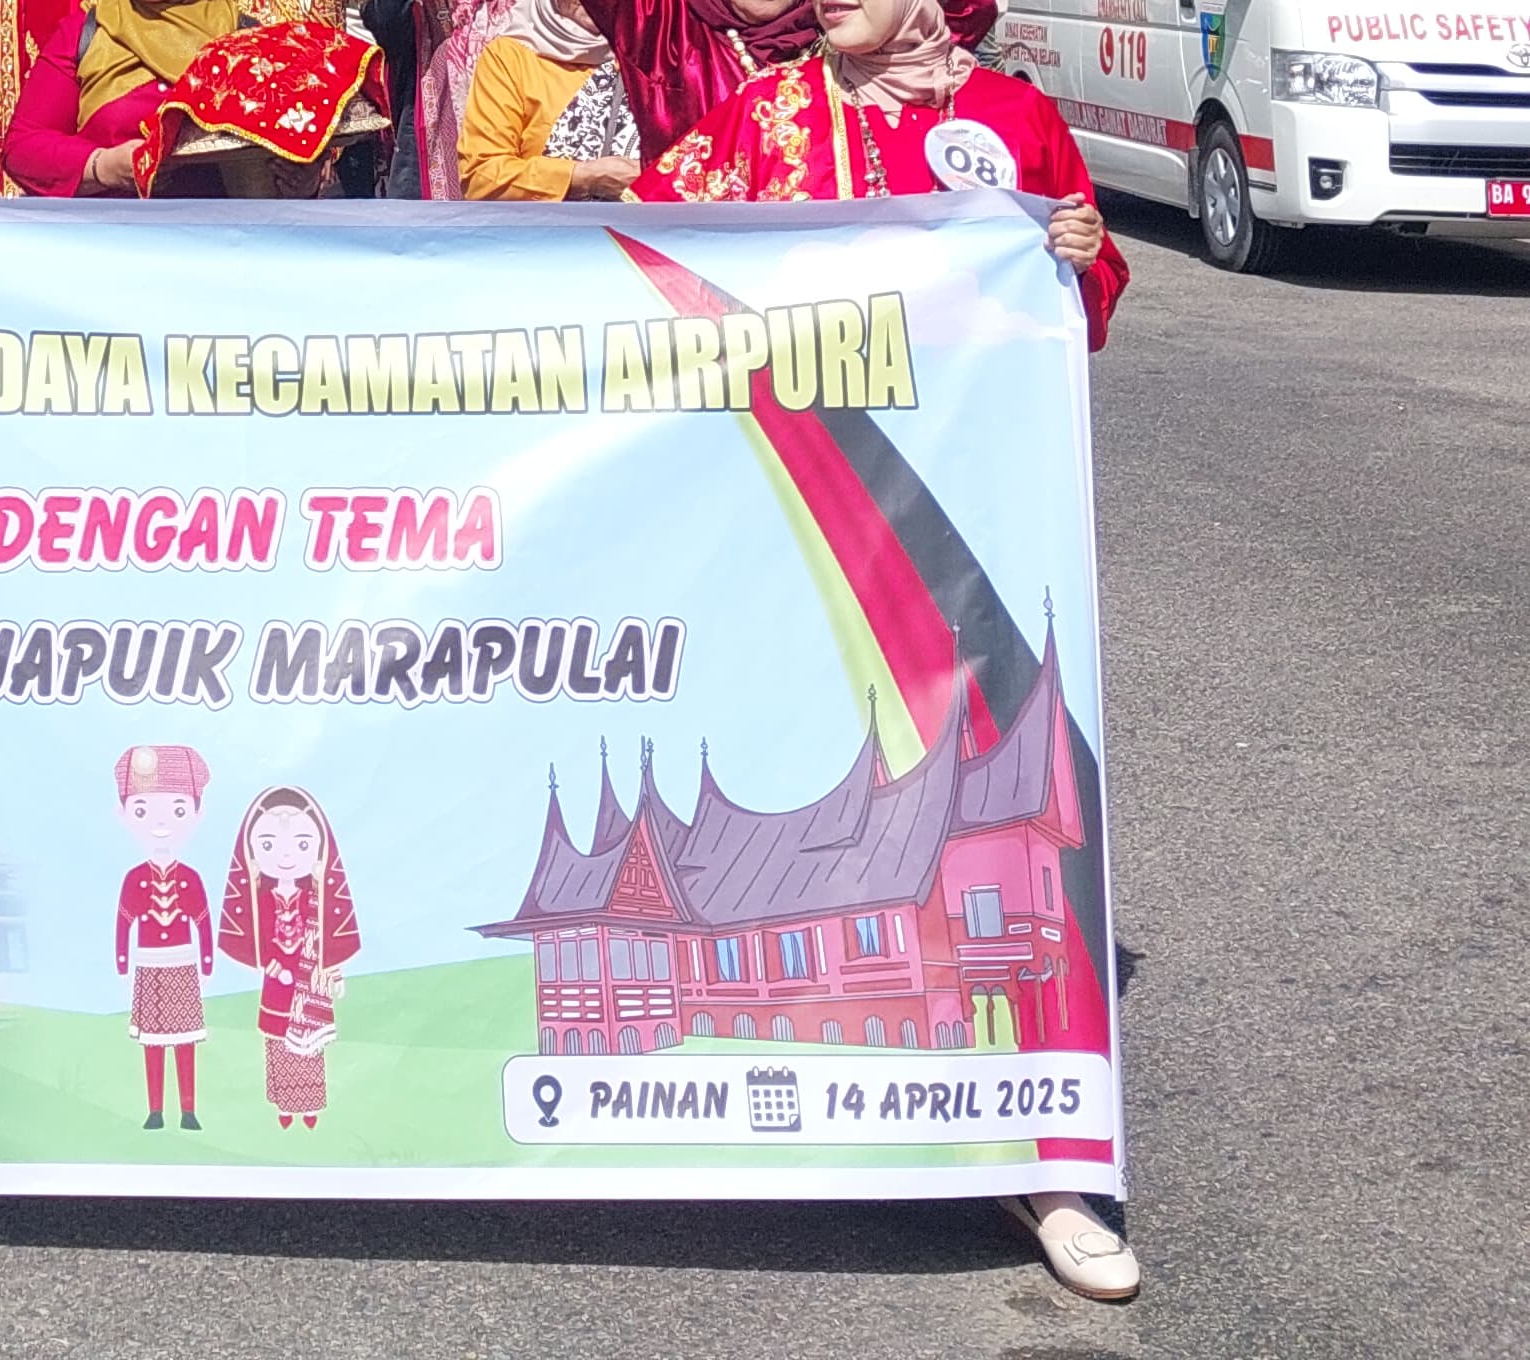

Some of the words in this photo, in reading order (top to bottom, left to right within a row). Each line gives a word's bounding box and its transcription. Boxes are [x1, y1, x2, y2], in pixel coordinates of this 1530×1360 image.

[1327, 13, 1428, 43] PUBLIC
[1435, 13, 1530, 42] SAFETY
[1118, 30, 1147, 81] 119
[1126, 112, 1168, 145] DARURAT
[944, 145, 999, 187] 08
[1491, 183, 1514, 204] BA
[164, 325, 587, 417] KECAMATAN
[601, 291, 919, 413] AIRPURA
[307, 492, 497, 565] TEMA
[255, 622, 682, 701] MARAPULAI
[589, 1080, 728, 1119] PAINAN
[826, 1081, 866, 1120] 14
[879, 1079, 982, 1120] APRIL
[997, 1077, 1082, 1118] 2025
